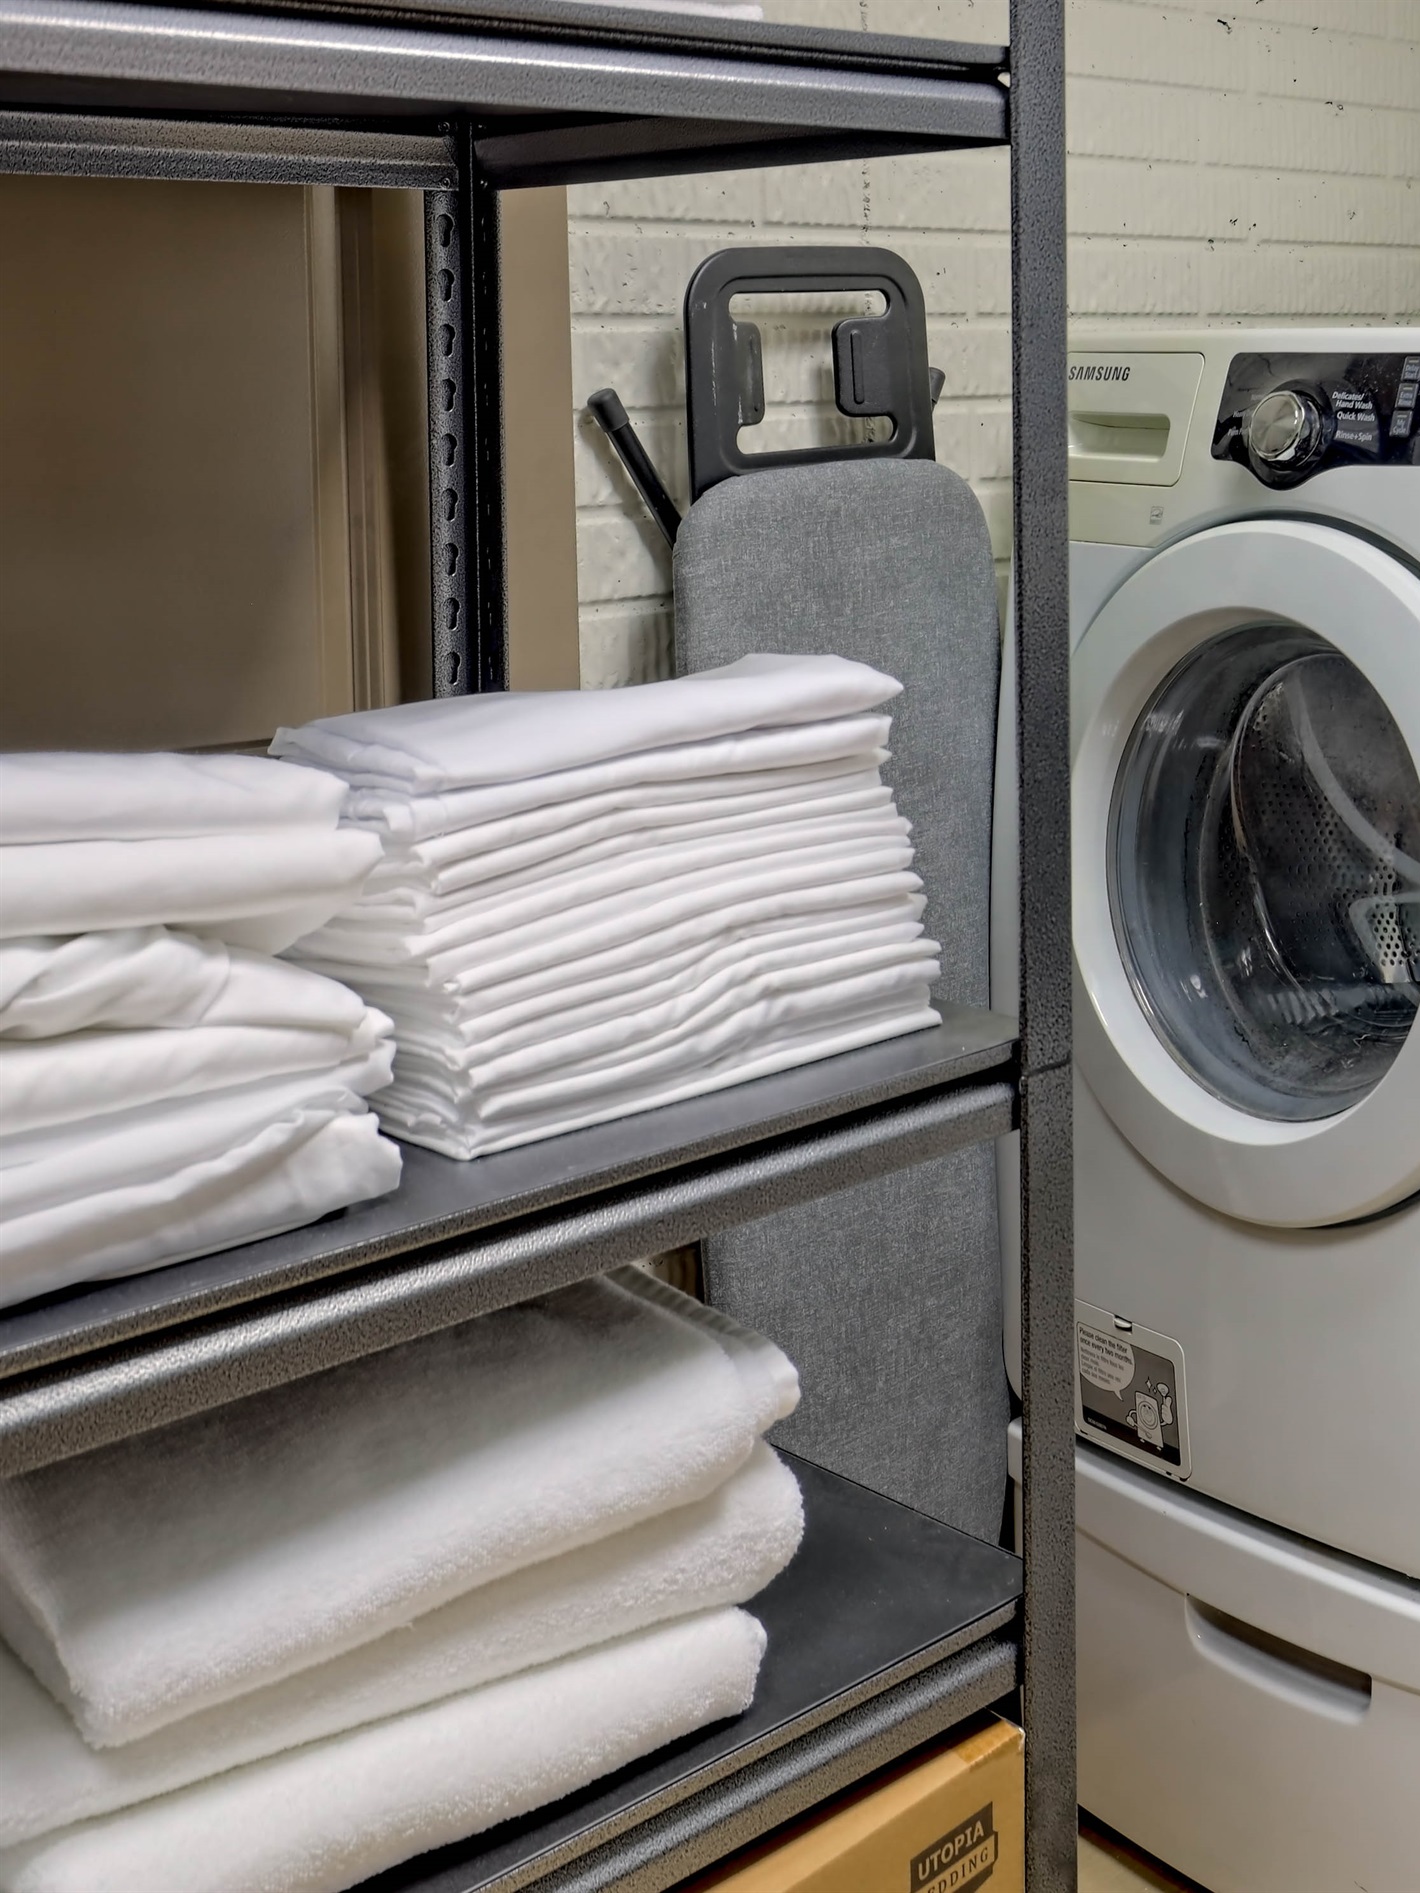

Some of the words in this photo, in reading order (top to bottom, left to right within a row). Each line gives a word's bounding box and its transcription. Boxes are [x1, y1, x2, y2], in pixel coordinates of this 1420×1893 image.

[1068, 366, 1131, 381] SAMSUNG
[1406, 364, 1419, 372] Delay
[1404, 371, 1417, 379] Start
[1332, 391, 1365, 401] Delicates/
[1335, 399, 1353, 409] Hand
[1354, 401, 1373, 410] Wash
[1336, 411, 1355, 421] Quick
[1356, 412, 1375, 421] Wash
[1335, 431, 1373, 442] Rinse+Spin
[1092, 1342, 1104, 1353] every
[1095, 1335, 1107, 1345] clean
[1108, 1340, 1116, 1349] the
[918, 1820, 984, 1881] UTOPIA
[927, 1846, 989, 1893] DDING
